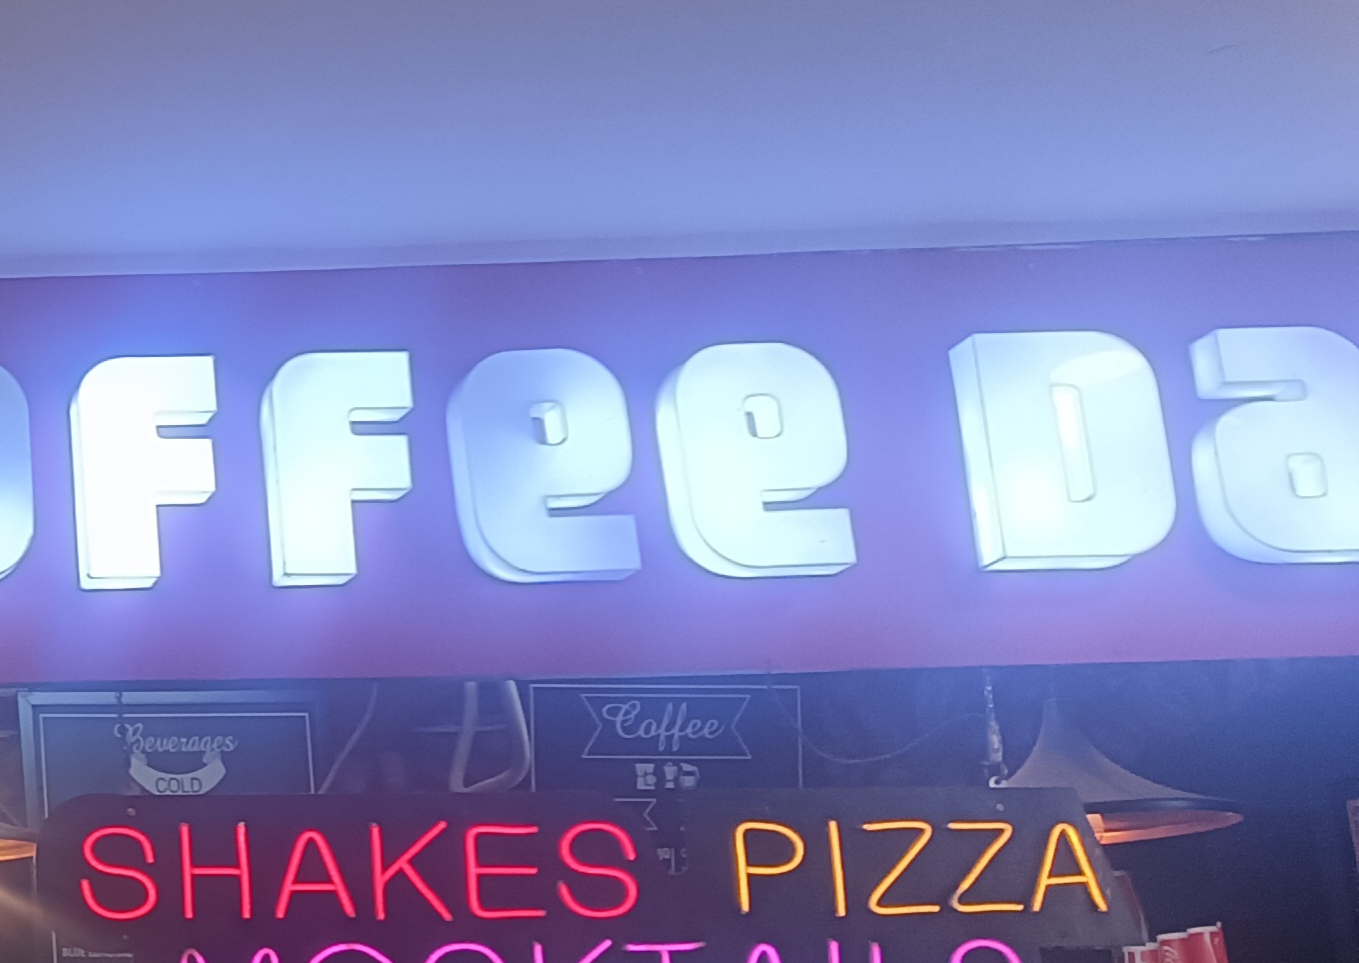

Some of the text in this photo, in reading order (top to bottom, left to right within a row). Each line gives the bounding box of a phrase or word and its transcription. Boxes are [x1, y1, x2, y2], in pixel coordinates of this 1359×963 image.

[114, 723, 238, 754] Beverages
[602, 700, 726, 752] Coffee
[155, 777, 203, 795] COLD
[81, 819, 1109, 921] SHAKES PIZZA
